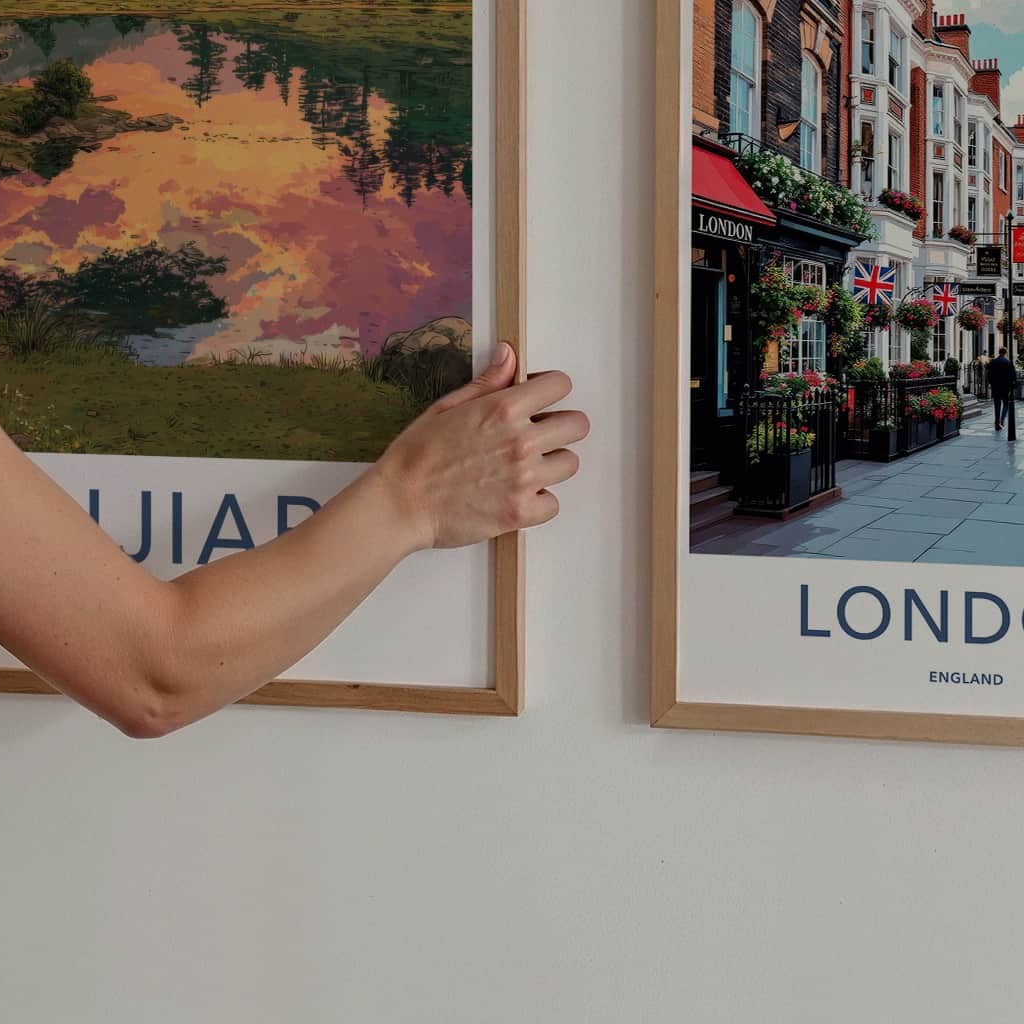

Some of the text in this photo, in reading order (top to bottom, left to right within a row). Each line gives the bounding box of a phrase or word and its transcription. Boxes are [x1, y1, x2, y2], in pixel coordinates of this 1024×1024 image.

[698, 213, 753, 242] LONDON
[800, 583, 1024, 645] LOND
[929, 671, 1004, 686] ENGLAND
